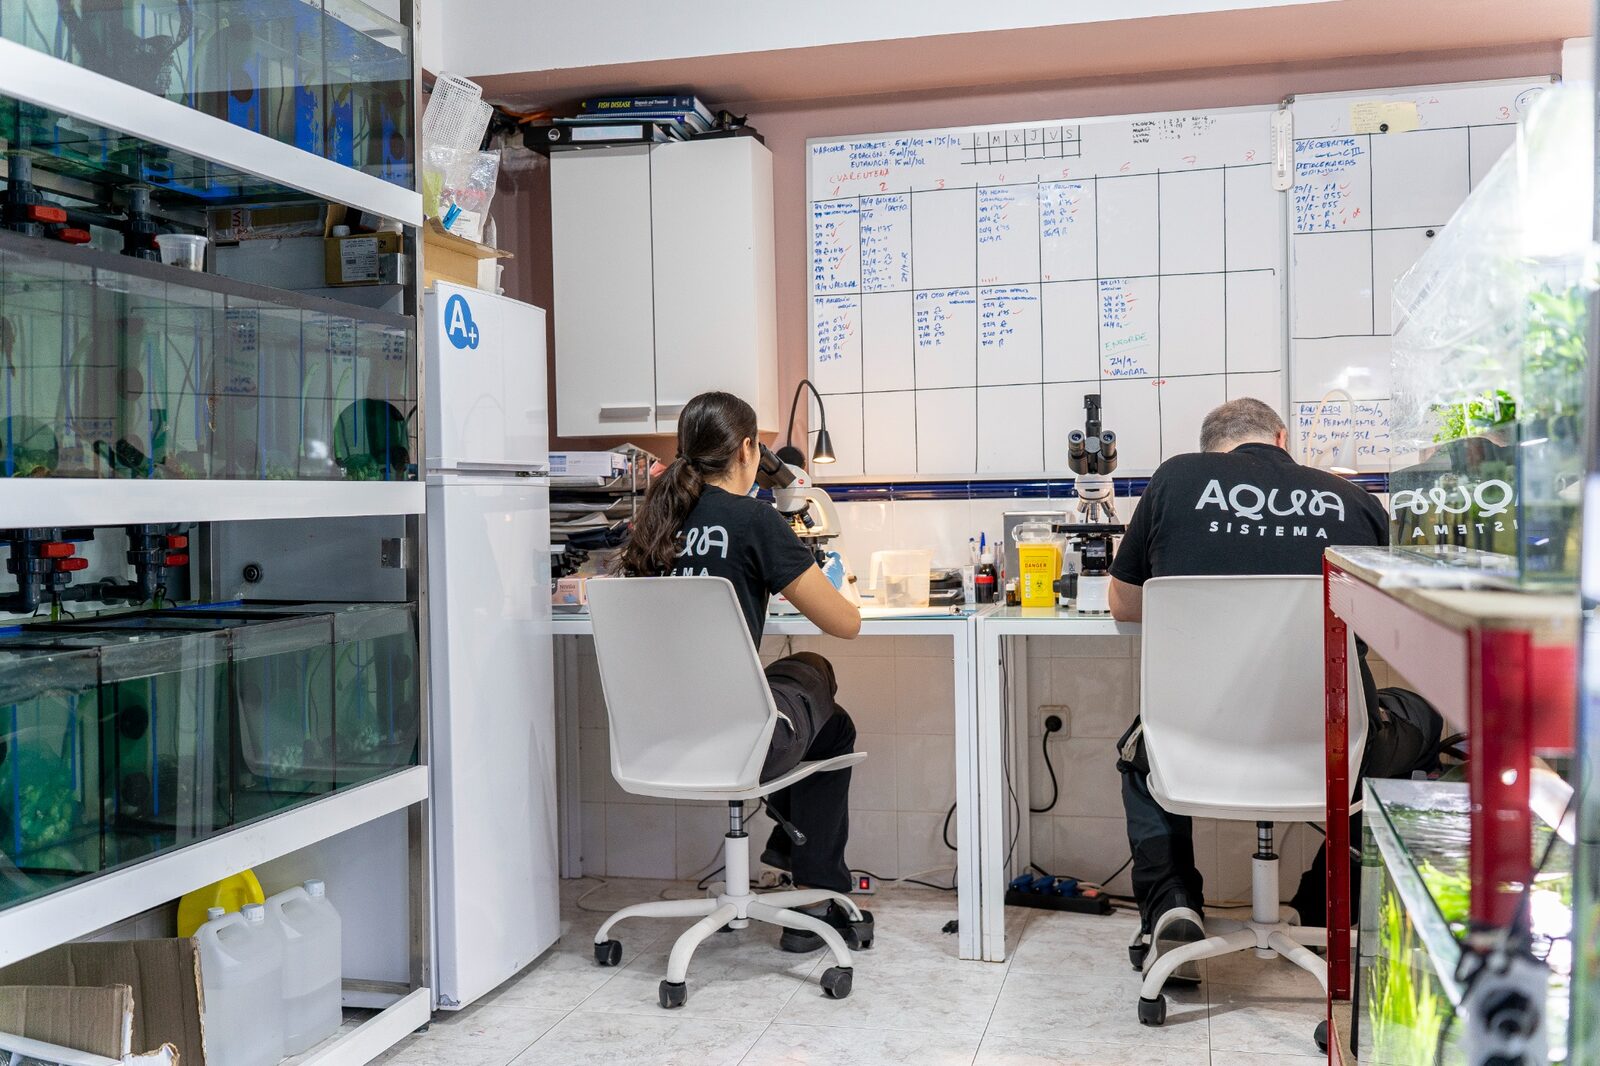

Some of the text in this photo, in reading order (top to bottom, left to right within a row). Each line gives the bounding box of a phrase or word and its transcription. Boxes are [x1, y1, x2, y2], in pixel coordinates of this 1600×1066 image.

[598, 101, 610, 109] FISH
[610, 100, 631, 108] DISEASE
[992, 135, 1001, 144] M
[1013, 134, 1020, 143] X
[1030, 130, 1037, 141] J
[1049, 130, 1059, 140] V
[1066, 129, 1073, 139] S
[879, 182, 889, 192] 2
[1194, 478, 1346, 522] AQUA
[1208, 521, 1329, 540] SISTEMA
